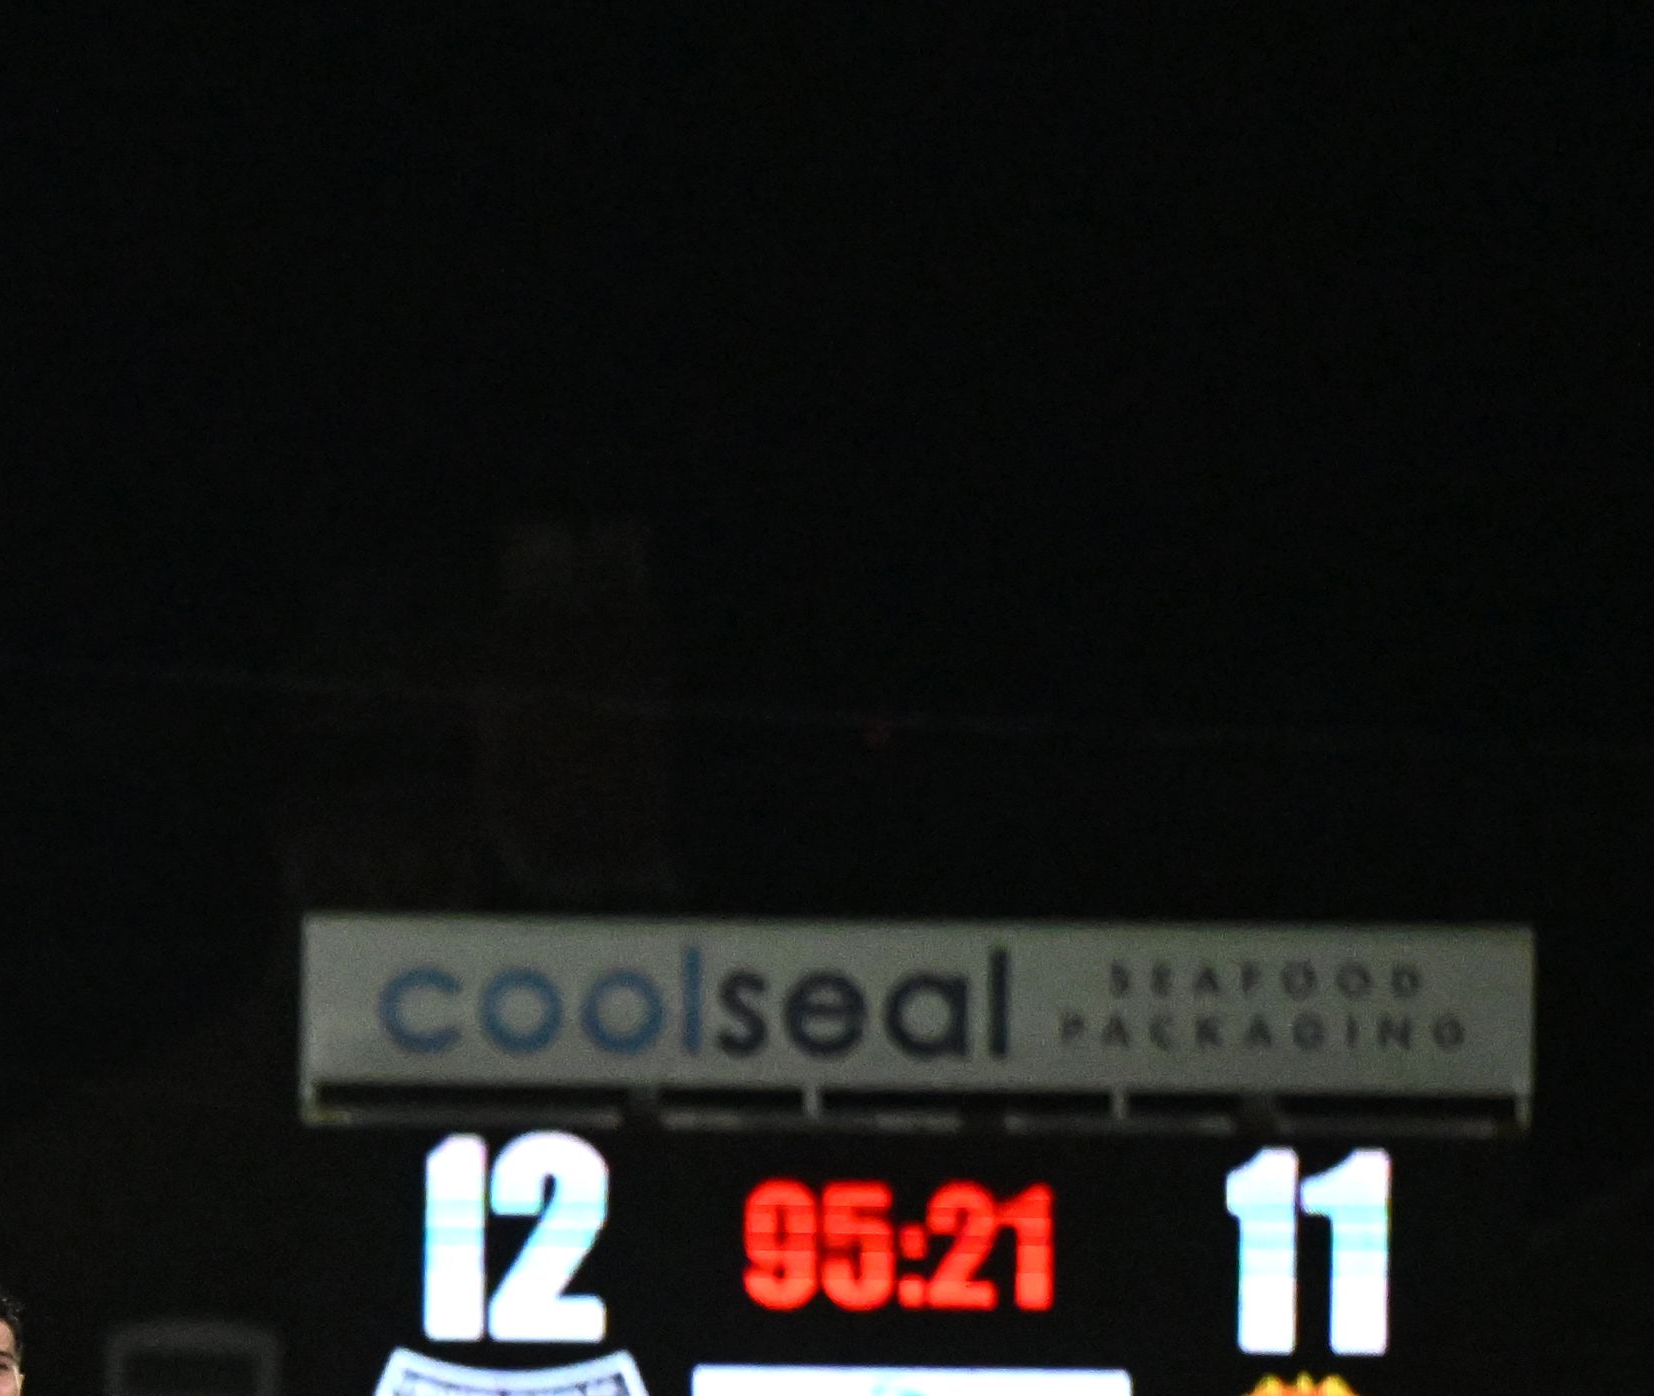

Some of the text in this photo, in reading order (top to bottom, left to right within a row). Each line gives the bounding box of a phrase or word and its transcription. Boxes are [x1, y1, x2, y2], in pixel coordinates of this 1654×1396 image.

[379, 945, 1010, 1058] coolseal
[1061, 1011, 1465, 1051] PACKAGING
[1109, 959, 1422, 1000] SEAFOOD
[422, 1130, 608, 1342] 12
[743, 1180, 1054, 1310] 95:21
[1226, 1146, 1389, 1356] 11
